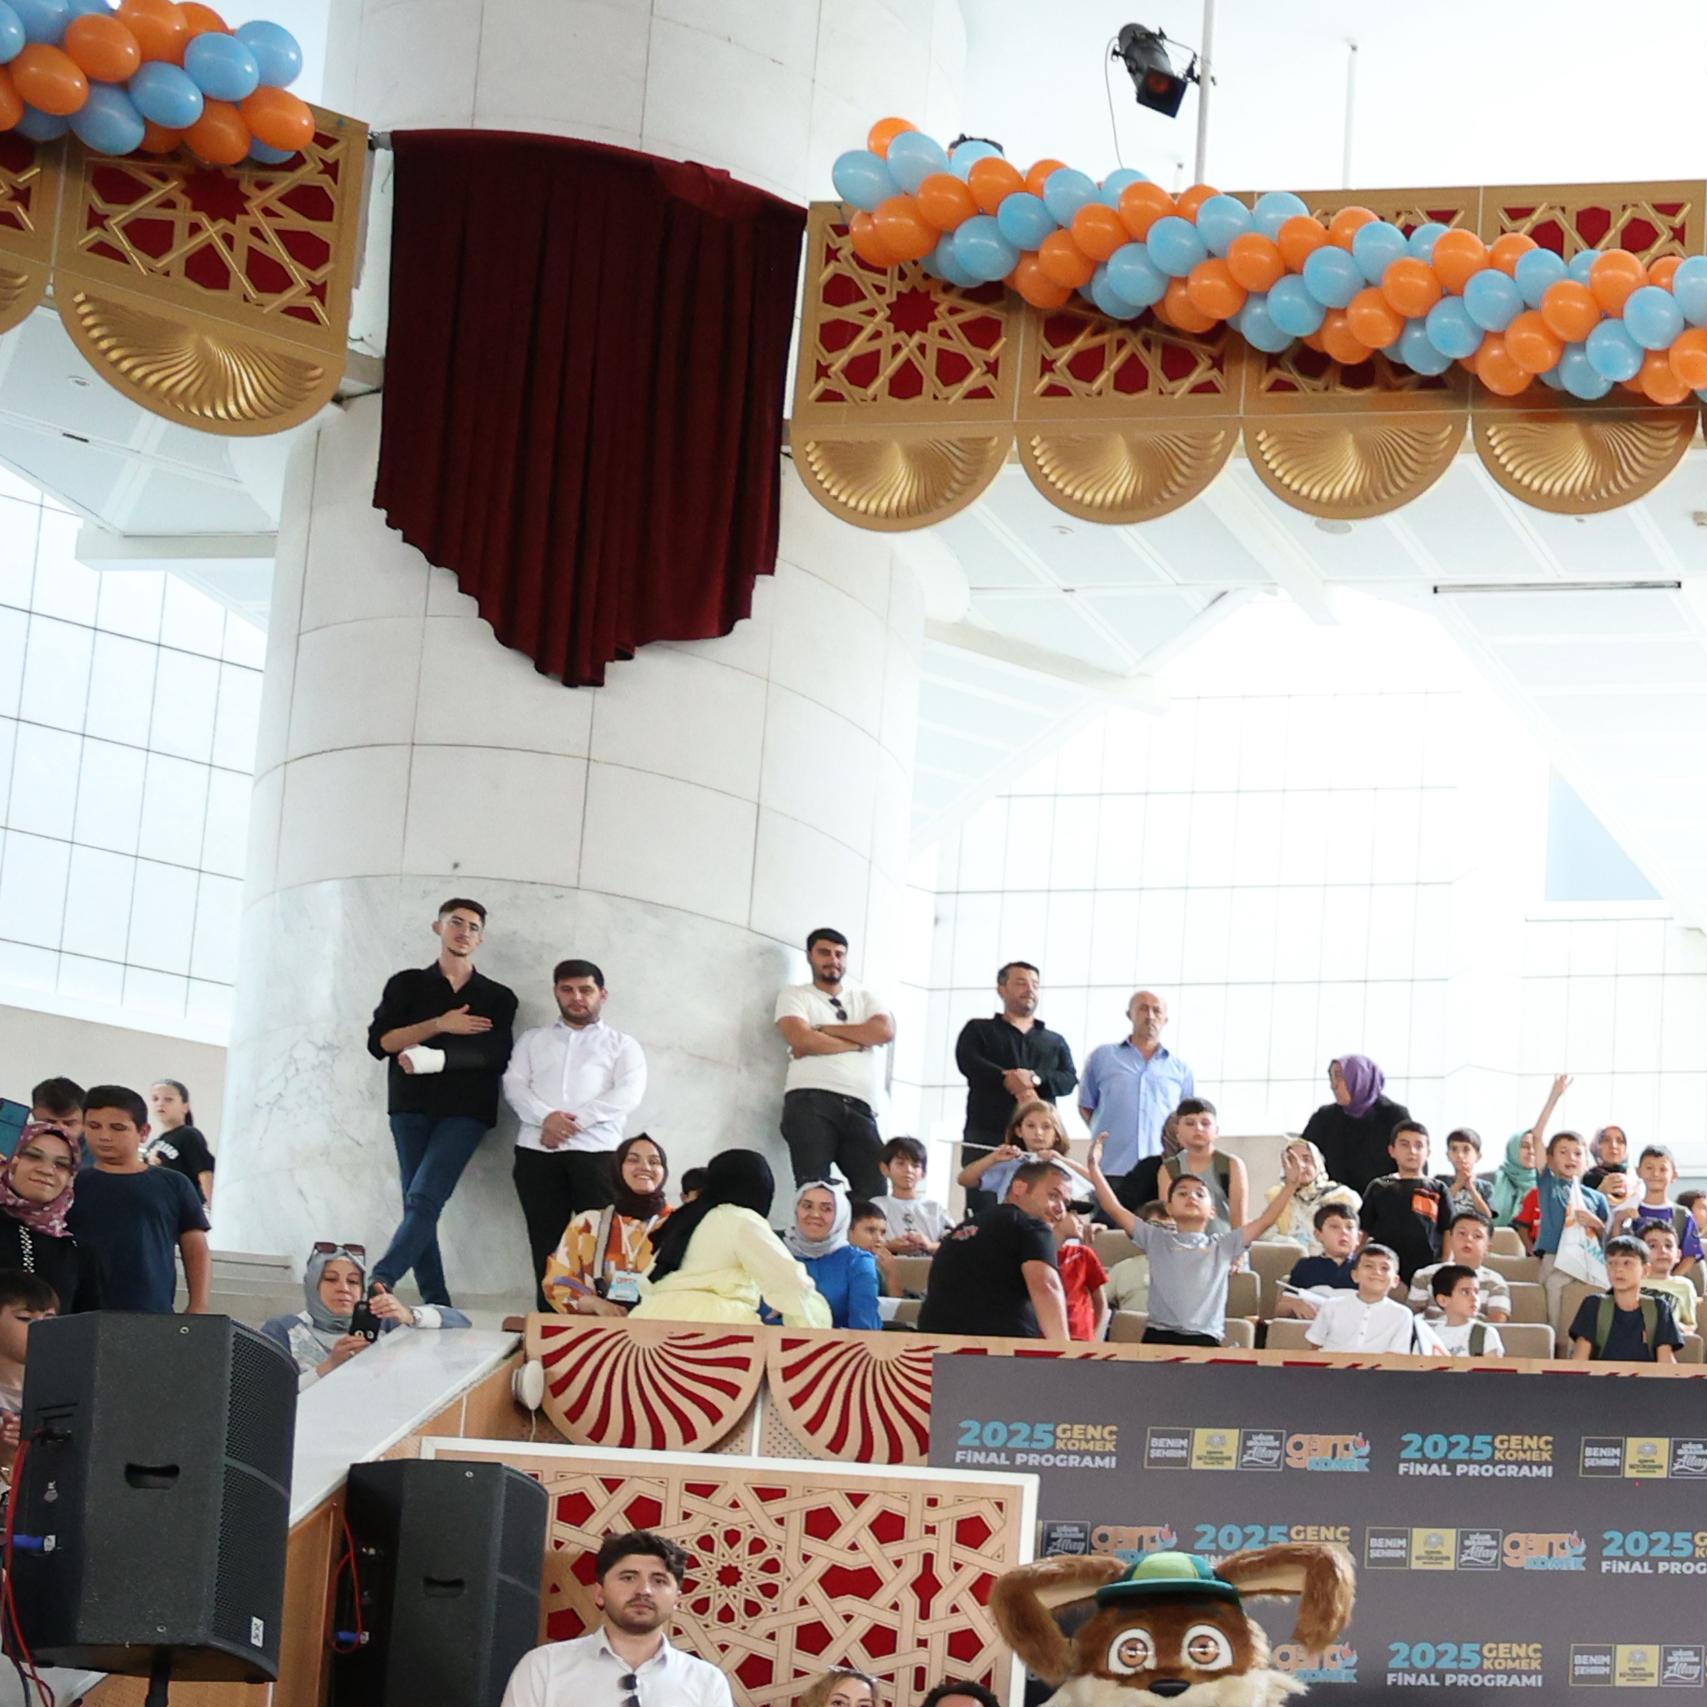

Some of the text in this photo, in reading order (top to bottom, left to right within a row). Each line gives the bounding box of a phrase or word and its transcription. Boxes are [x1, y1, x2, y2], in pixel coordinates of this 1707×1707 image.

[959, 1420, 1055, 1449] 2025
[1056, 1438, 1116, 1451] KOMEK
[1400, 1432, 1493, 1460] 2025
[1016, 1454, 1116, 1468] PROGRAMI
[1496, 1450, 1553, 1462] KOMEK
[1456, 1464, 1552, 1477] PROGRAMI
[1194, 1523, 1288, 1551] 2025
[1603, 1529, 1693, 1557] 2025
[1389, 1641, 1481, 1669] 2025
[1485, 1658, 1541, 1670] KOMEK
[1445, 1674, 1542, 1687] PROGRAMI
